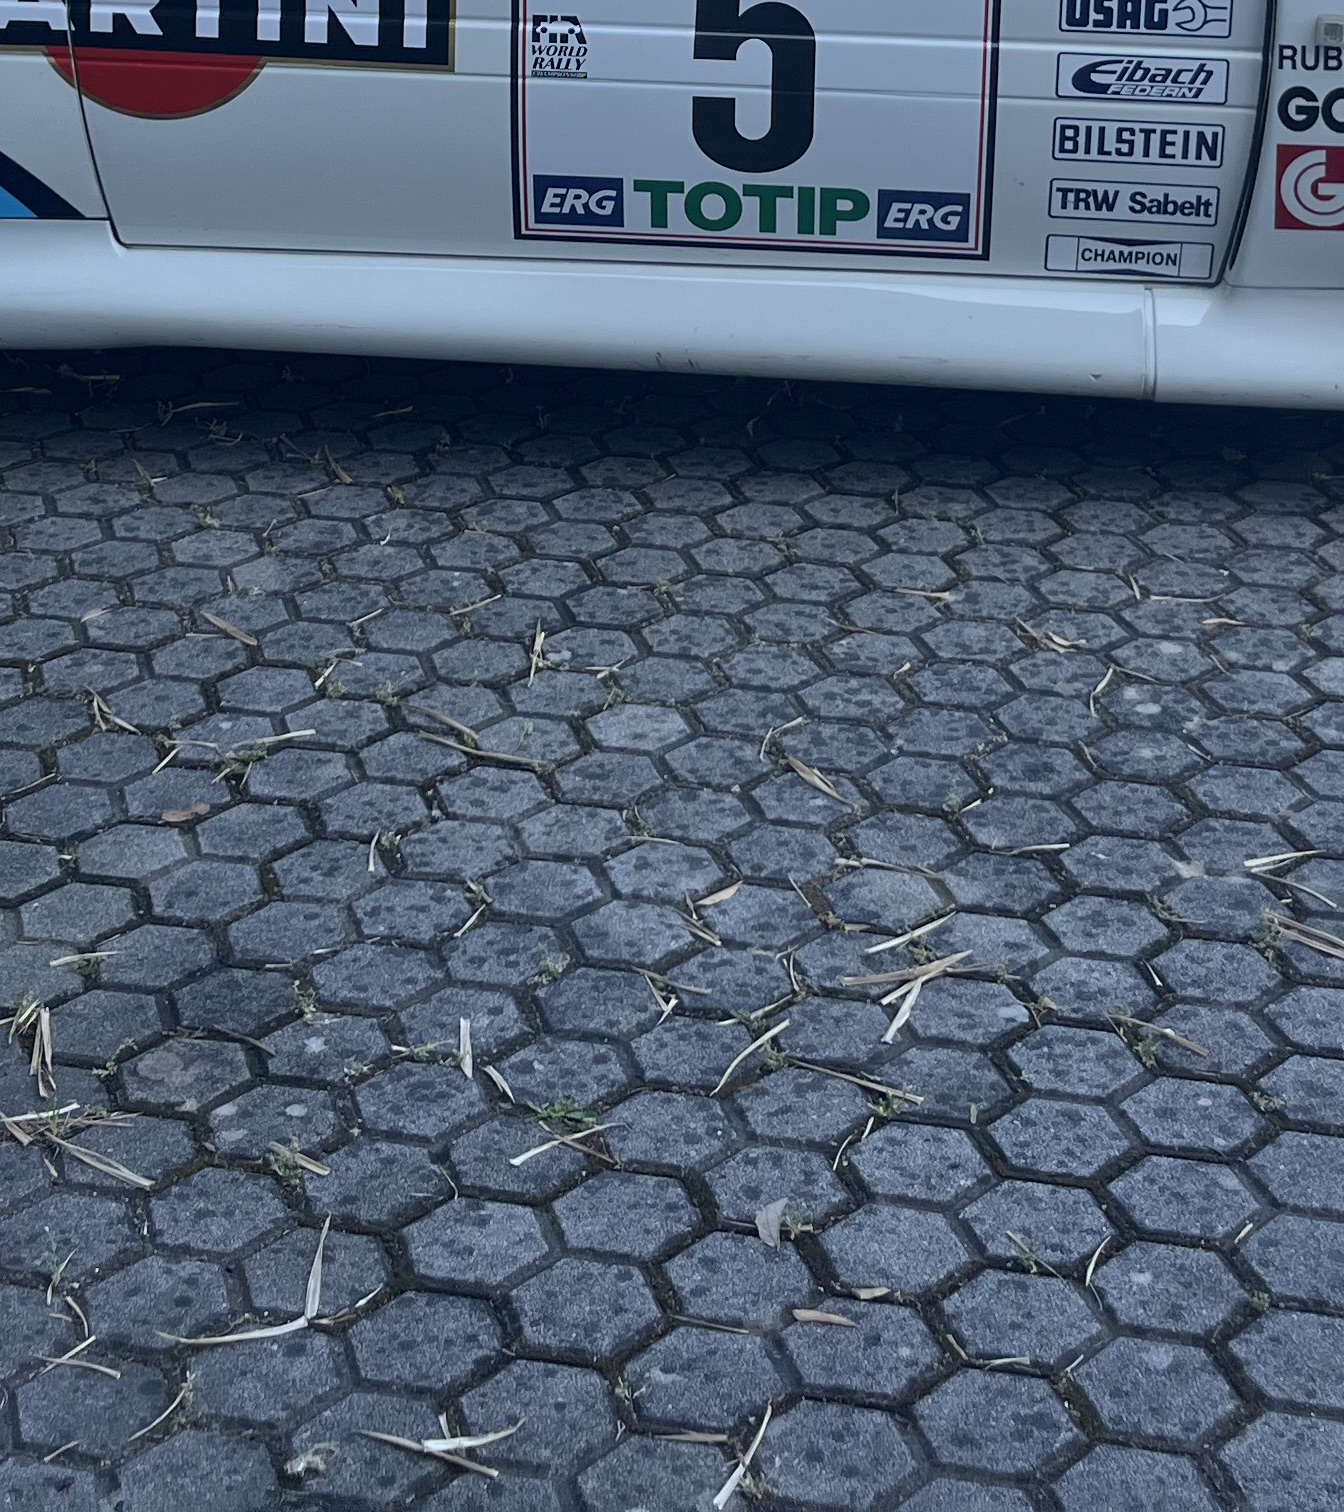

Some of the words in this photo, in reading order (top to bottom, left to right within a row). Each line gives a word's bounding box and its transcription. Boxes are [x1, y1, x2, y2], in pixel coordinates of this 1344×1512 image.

[531, 44, 588, 58] WORLD
[532, 56, 586, 71] RALLY
[1071, 59, 1214, 95] Eibach
[1106, 83, 1202, 99] FEDERN
[1058, 124, 1219, 162] BILSTEIN
[540, 187, 618, 216] ERG
[633, 178, 871, 236] TOTIP
[883, 202, 963, 231] ERG
[1055, 187, 1120, 212] TRW
[1127, 191, 1213, 218] Sabelt
[1080, 247, 1178, 267] CHAMPION
